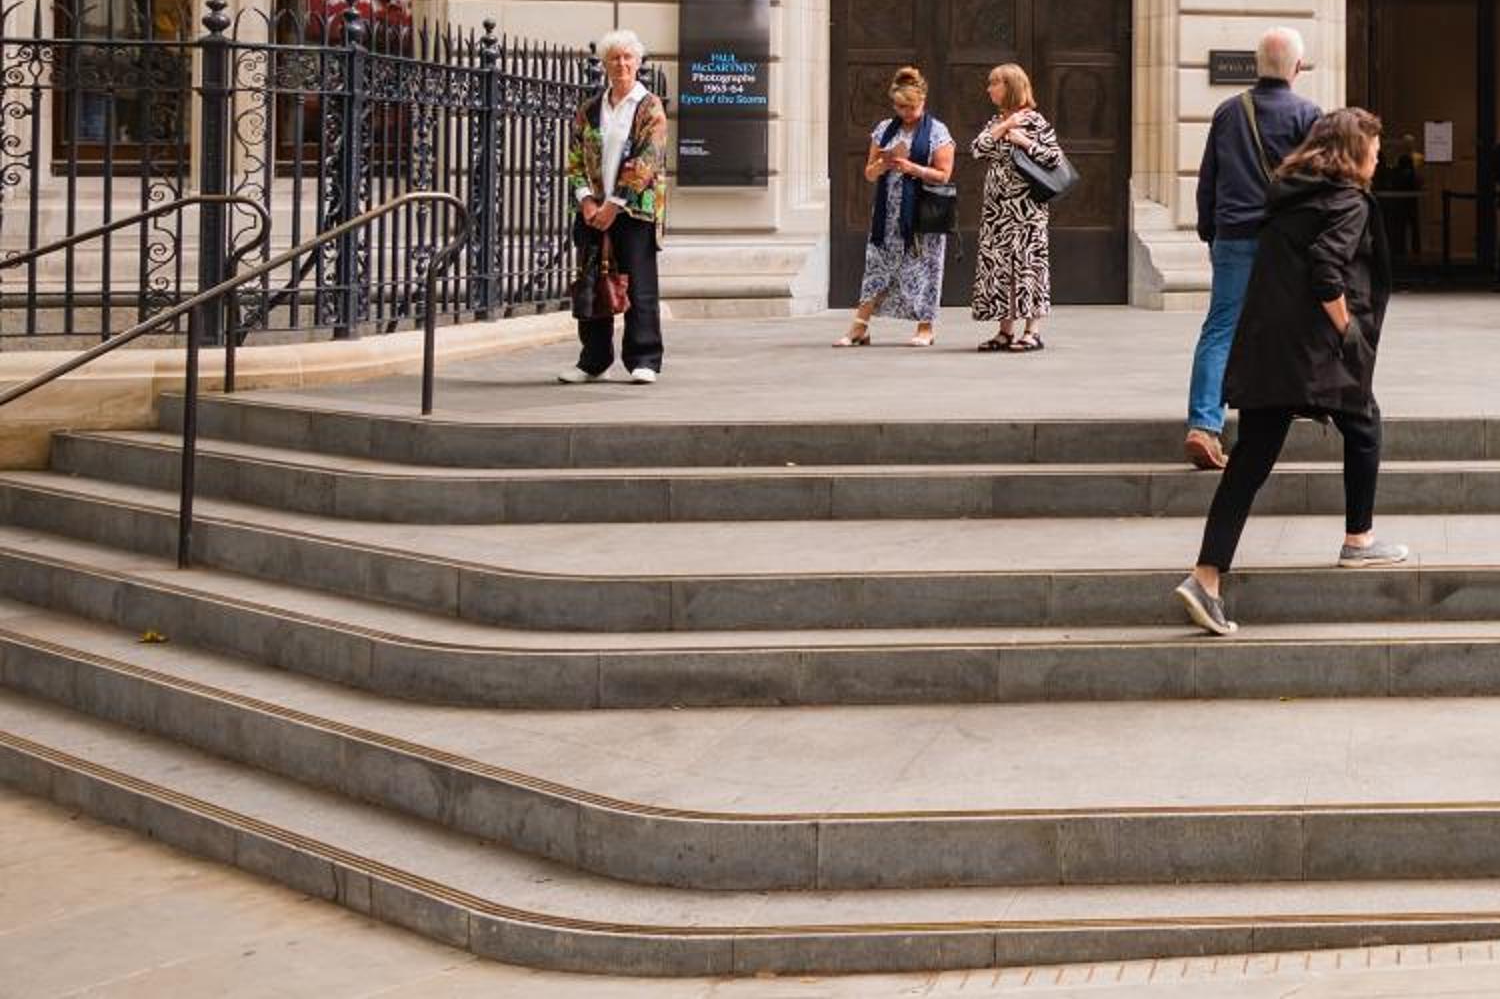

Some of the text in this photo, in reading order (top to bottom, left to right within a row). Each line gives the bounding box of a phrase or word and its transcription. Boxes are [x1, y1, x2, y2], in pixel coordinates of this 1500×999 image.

[692, 73, 756, 84] Photographs
[681, 94, 767, 105] Eyes of the Storm
